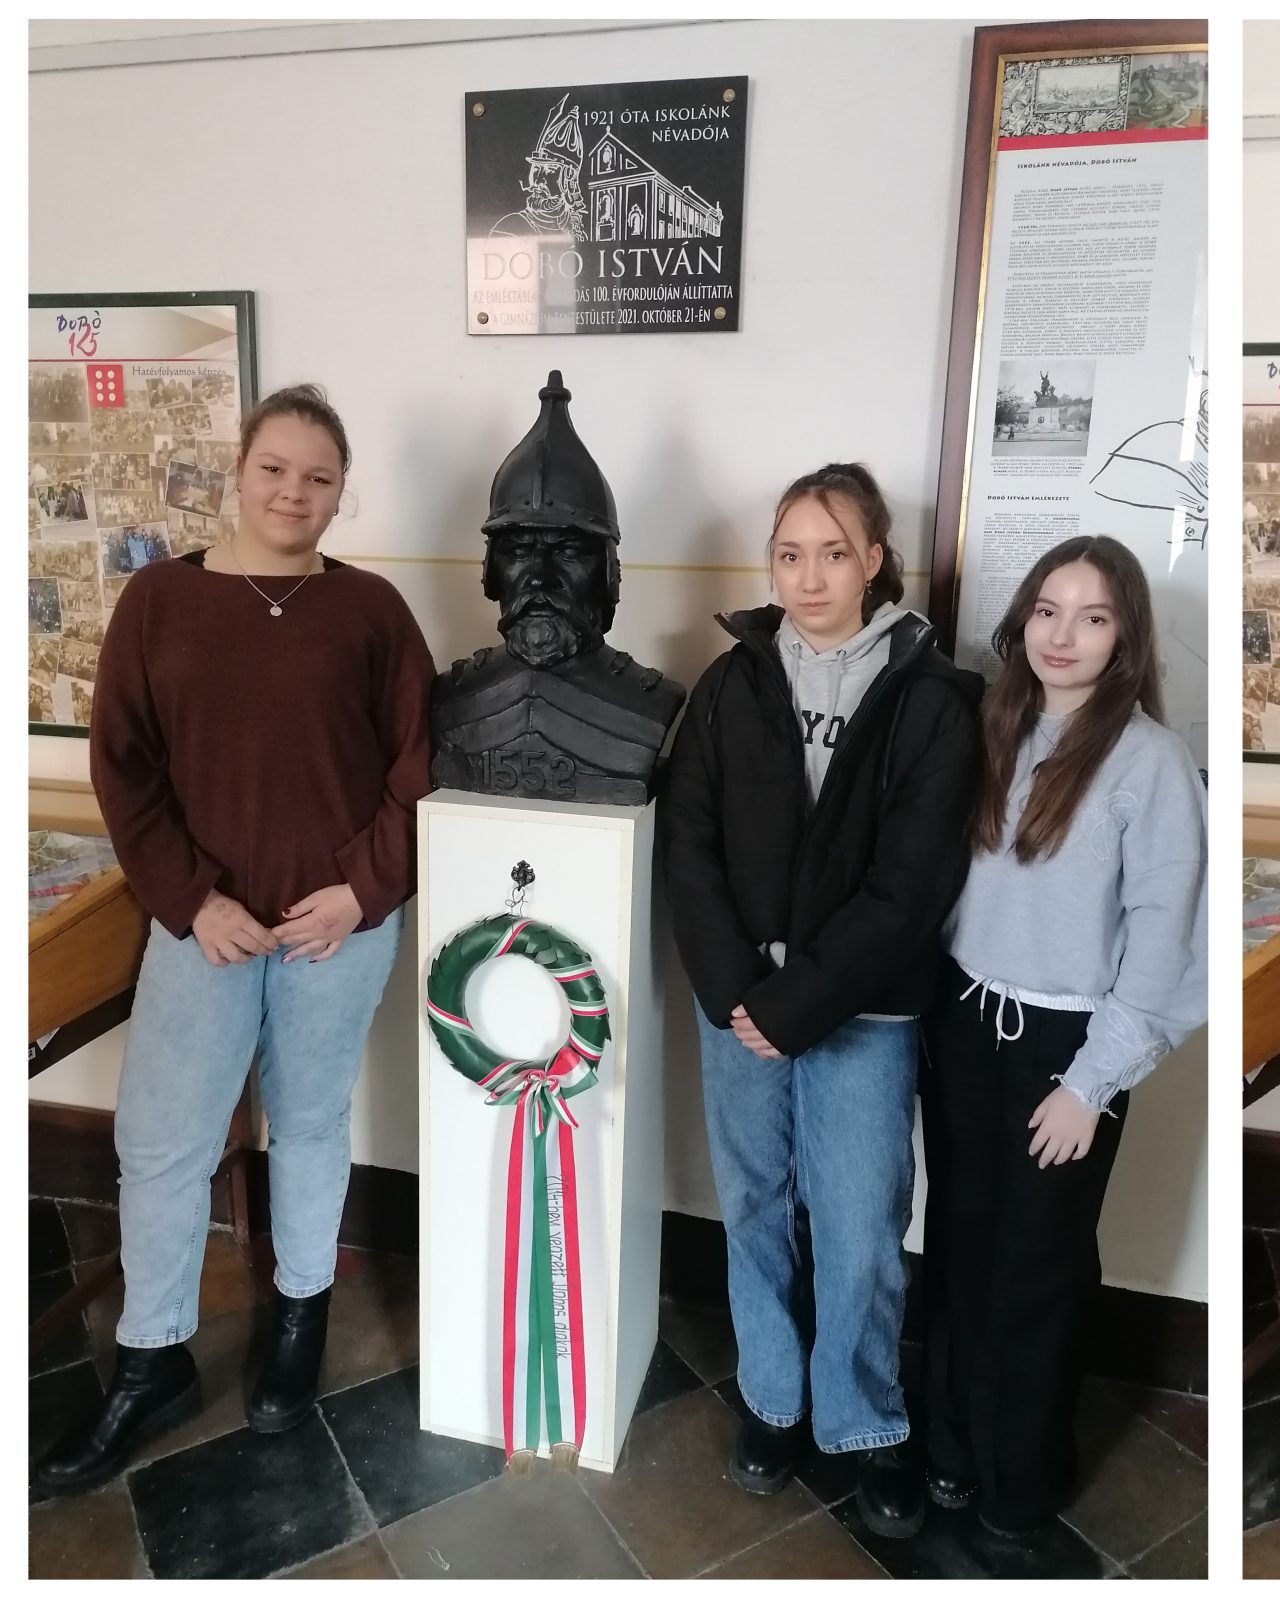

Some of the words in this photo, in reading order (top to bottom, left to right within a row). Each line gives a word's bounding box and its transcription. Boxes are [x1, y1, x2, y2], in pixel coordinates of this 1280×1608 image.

[583, 110, 614, 126] 1921
[620, 107, 649, 124] ÓTA
[655, 104, 730, 123] ISKOLÁNK
[652, 125, 729, 143] NÉVADÓJA
[480, 245, 584, 280] DOBÓ
[598, 241, 724, 278] ISTVÁN
[593, 286, 610, 302] 100.
[612, 283, 680, 302] ÉVFORDULÓJÁN
[682, 282, 734, 300] ÁLLÍTTATTA
[617, 308, 640, 324] 2021.
[642, 307, 682, 323] OKTÓBER
[684, 305, 711, 323] 21-ÉN
[69, 322, 100, 356] 125
[132, 366, 196, 377] Hatévfolyamos
[482, 750, 577, 798] 1552
